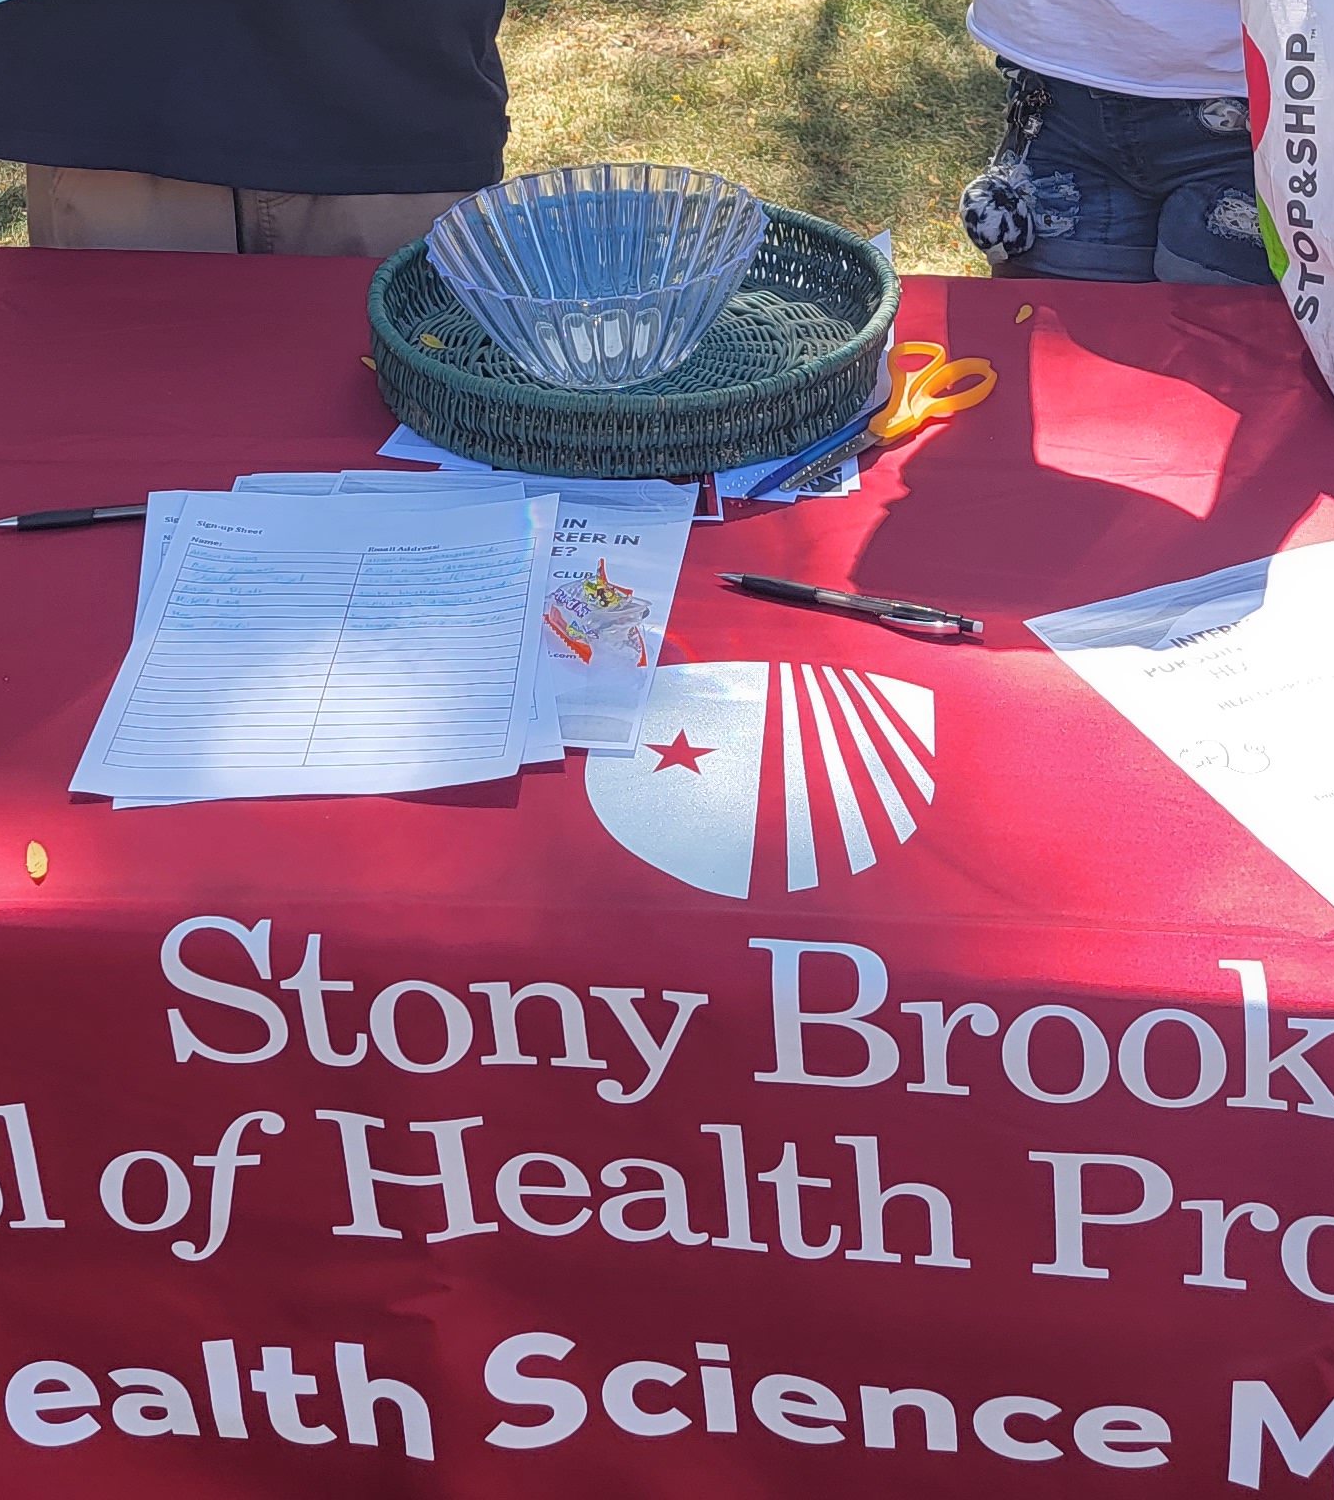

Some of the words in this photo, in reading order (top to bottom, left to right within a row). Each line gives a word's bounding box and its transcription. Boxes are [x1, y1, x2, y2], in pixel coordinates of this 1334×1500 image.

[1284, 33, 1326, 325] STOP&SHOP
[196, 519, 234, 533] Sign-up
[562, 518, 588, 529] IN
[614, 534, 641, 546] IN
[160, 913, 708, 1104] Stony
[98, 1110, 285, 1262] of
[315, 1109, 971, 1270] Health
[483, 1331, 1172, 1471] Science
